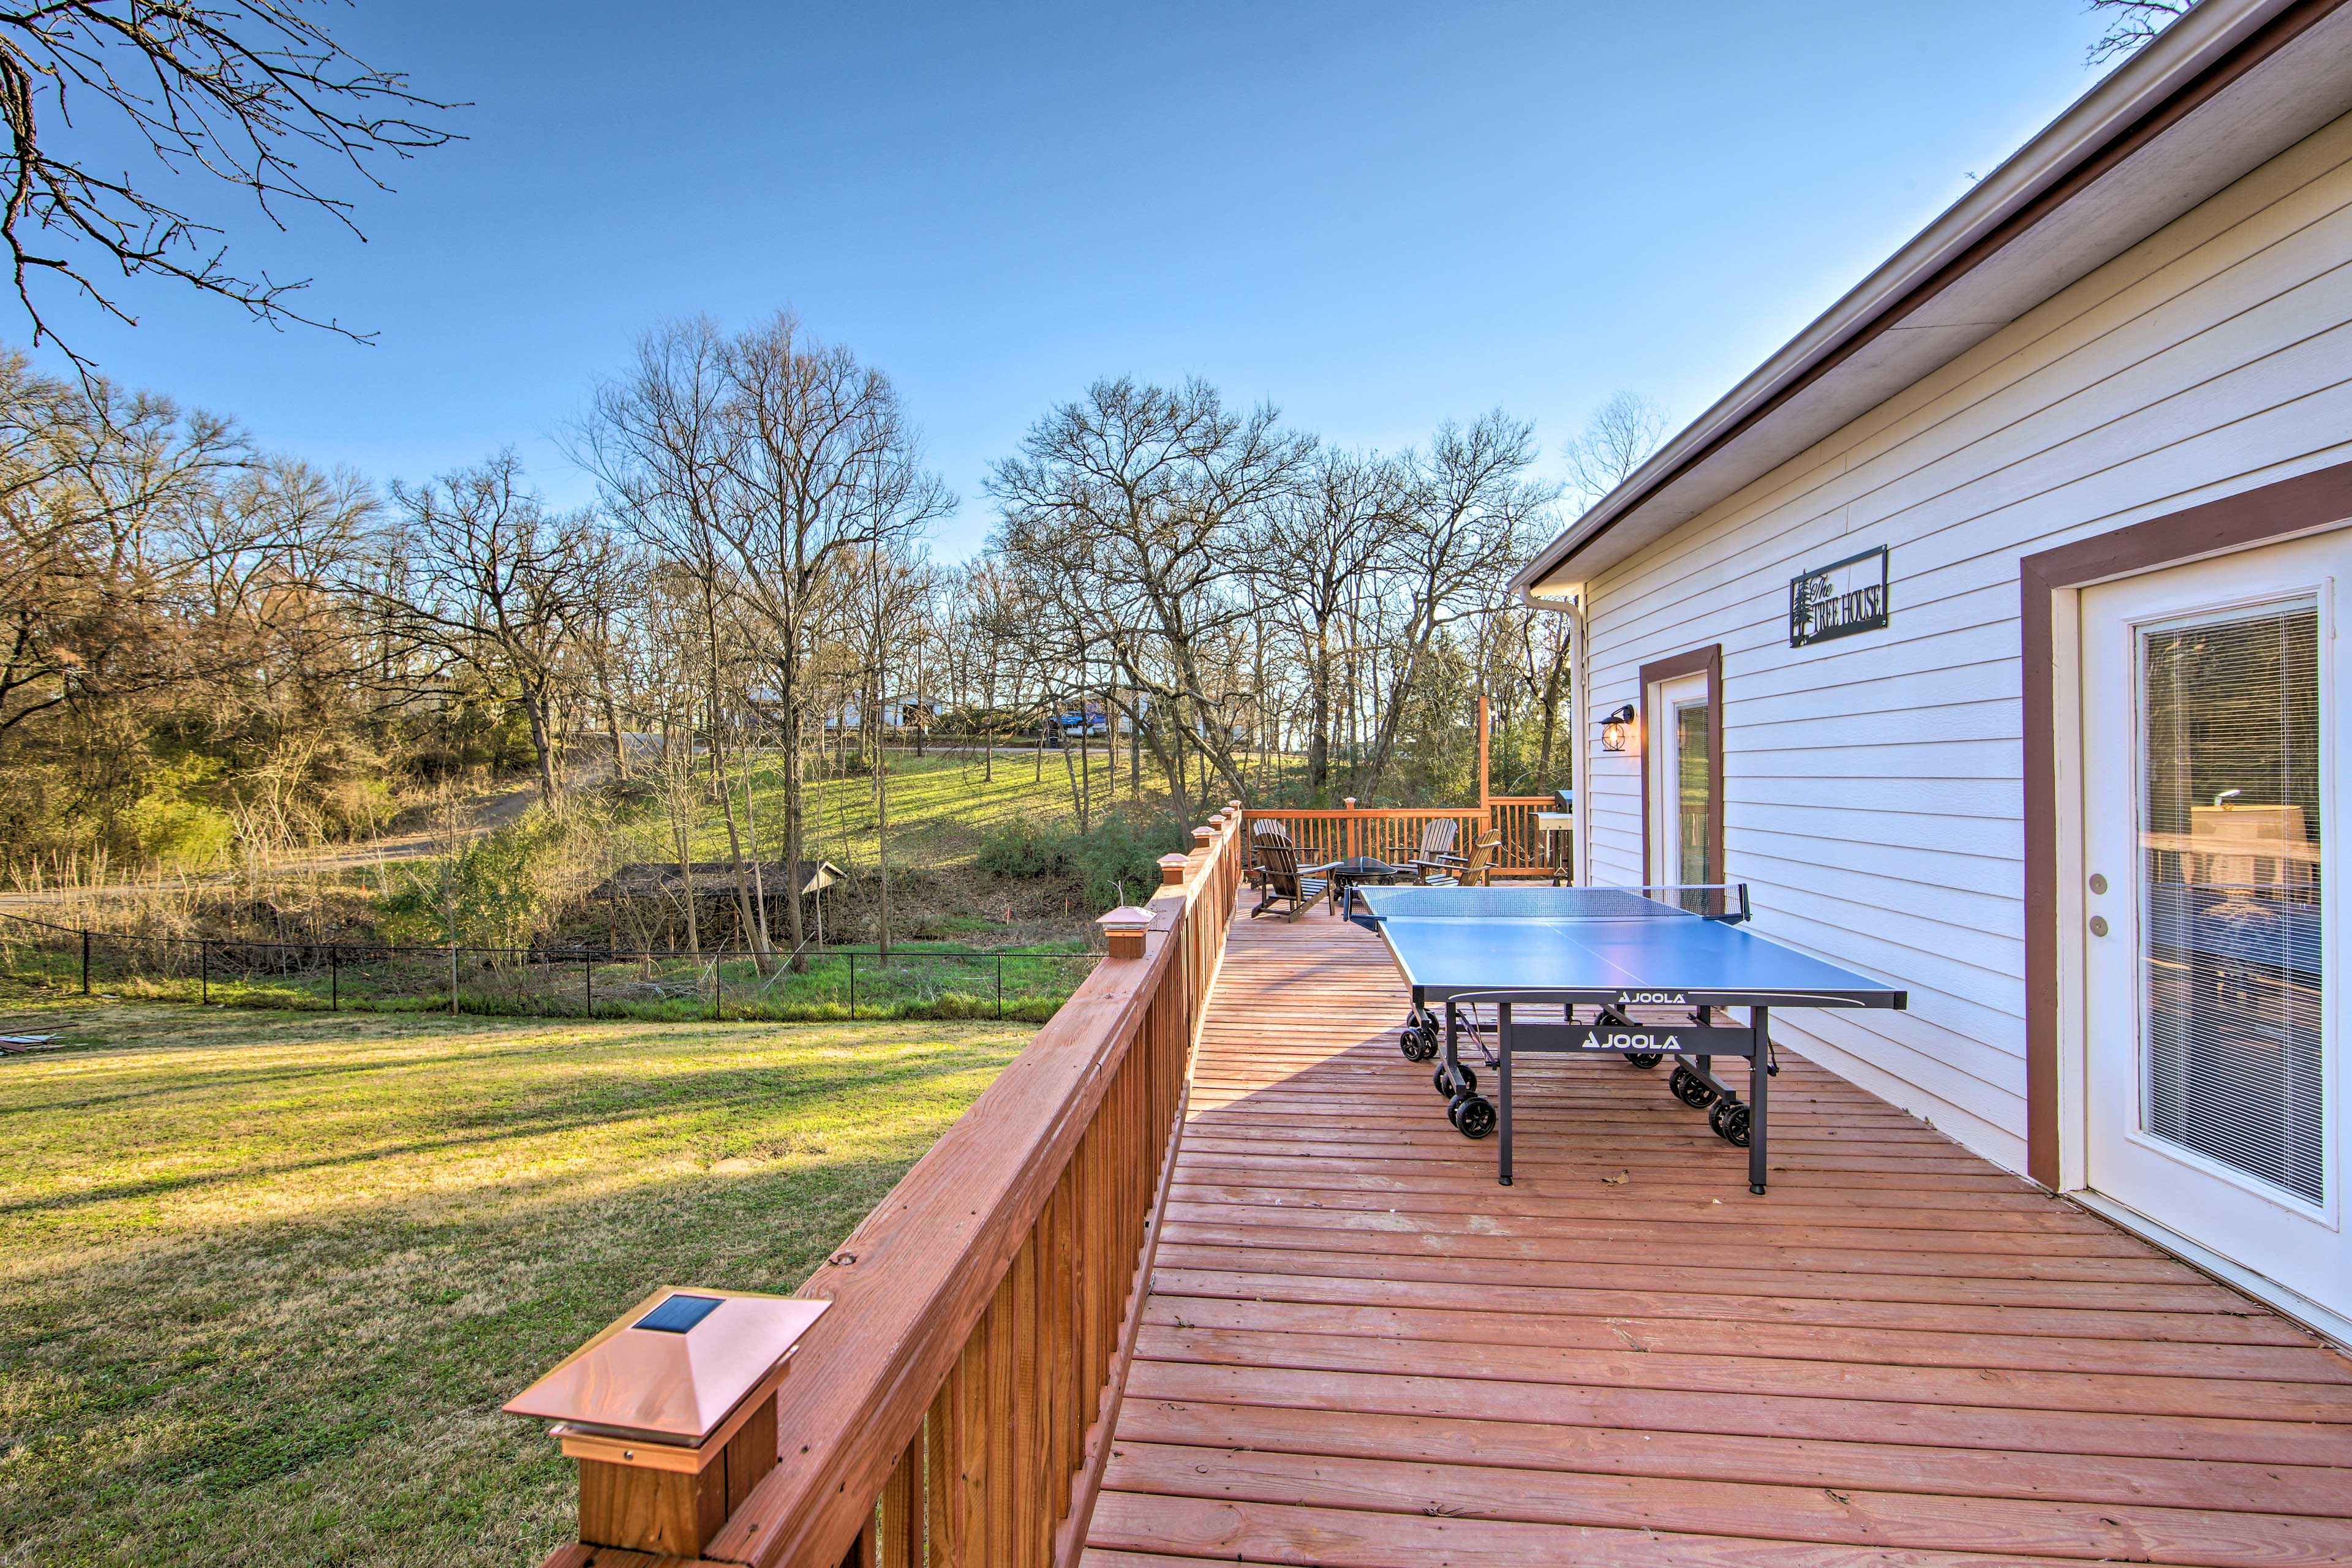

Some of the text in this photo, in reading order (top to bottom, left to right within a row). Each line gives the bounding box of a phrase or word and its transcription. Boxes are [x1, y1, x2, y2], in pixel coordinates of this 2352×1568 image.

[1809, 574, 1833, 603] The
[1812, 584, 1882, 633] TREE HOUSE
[1631, 993, 1686, 1003] JOOLA
[1601, 1034, 1681, 1049] JOOLA
